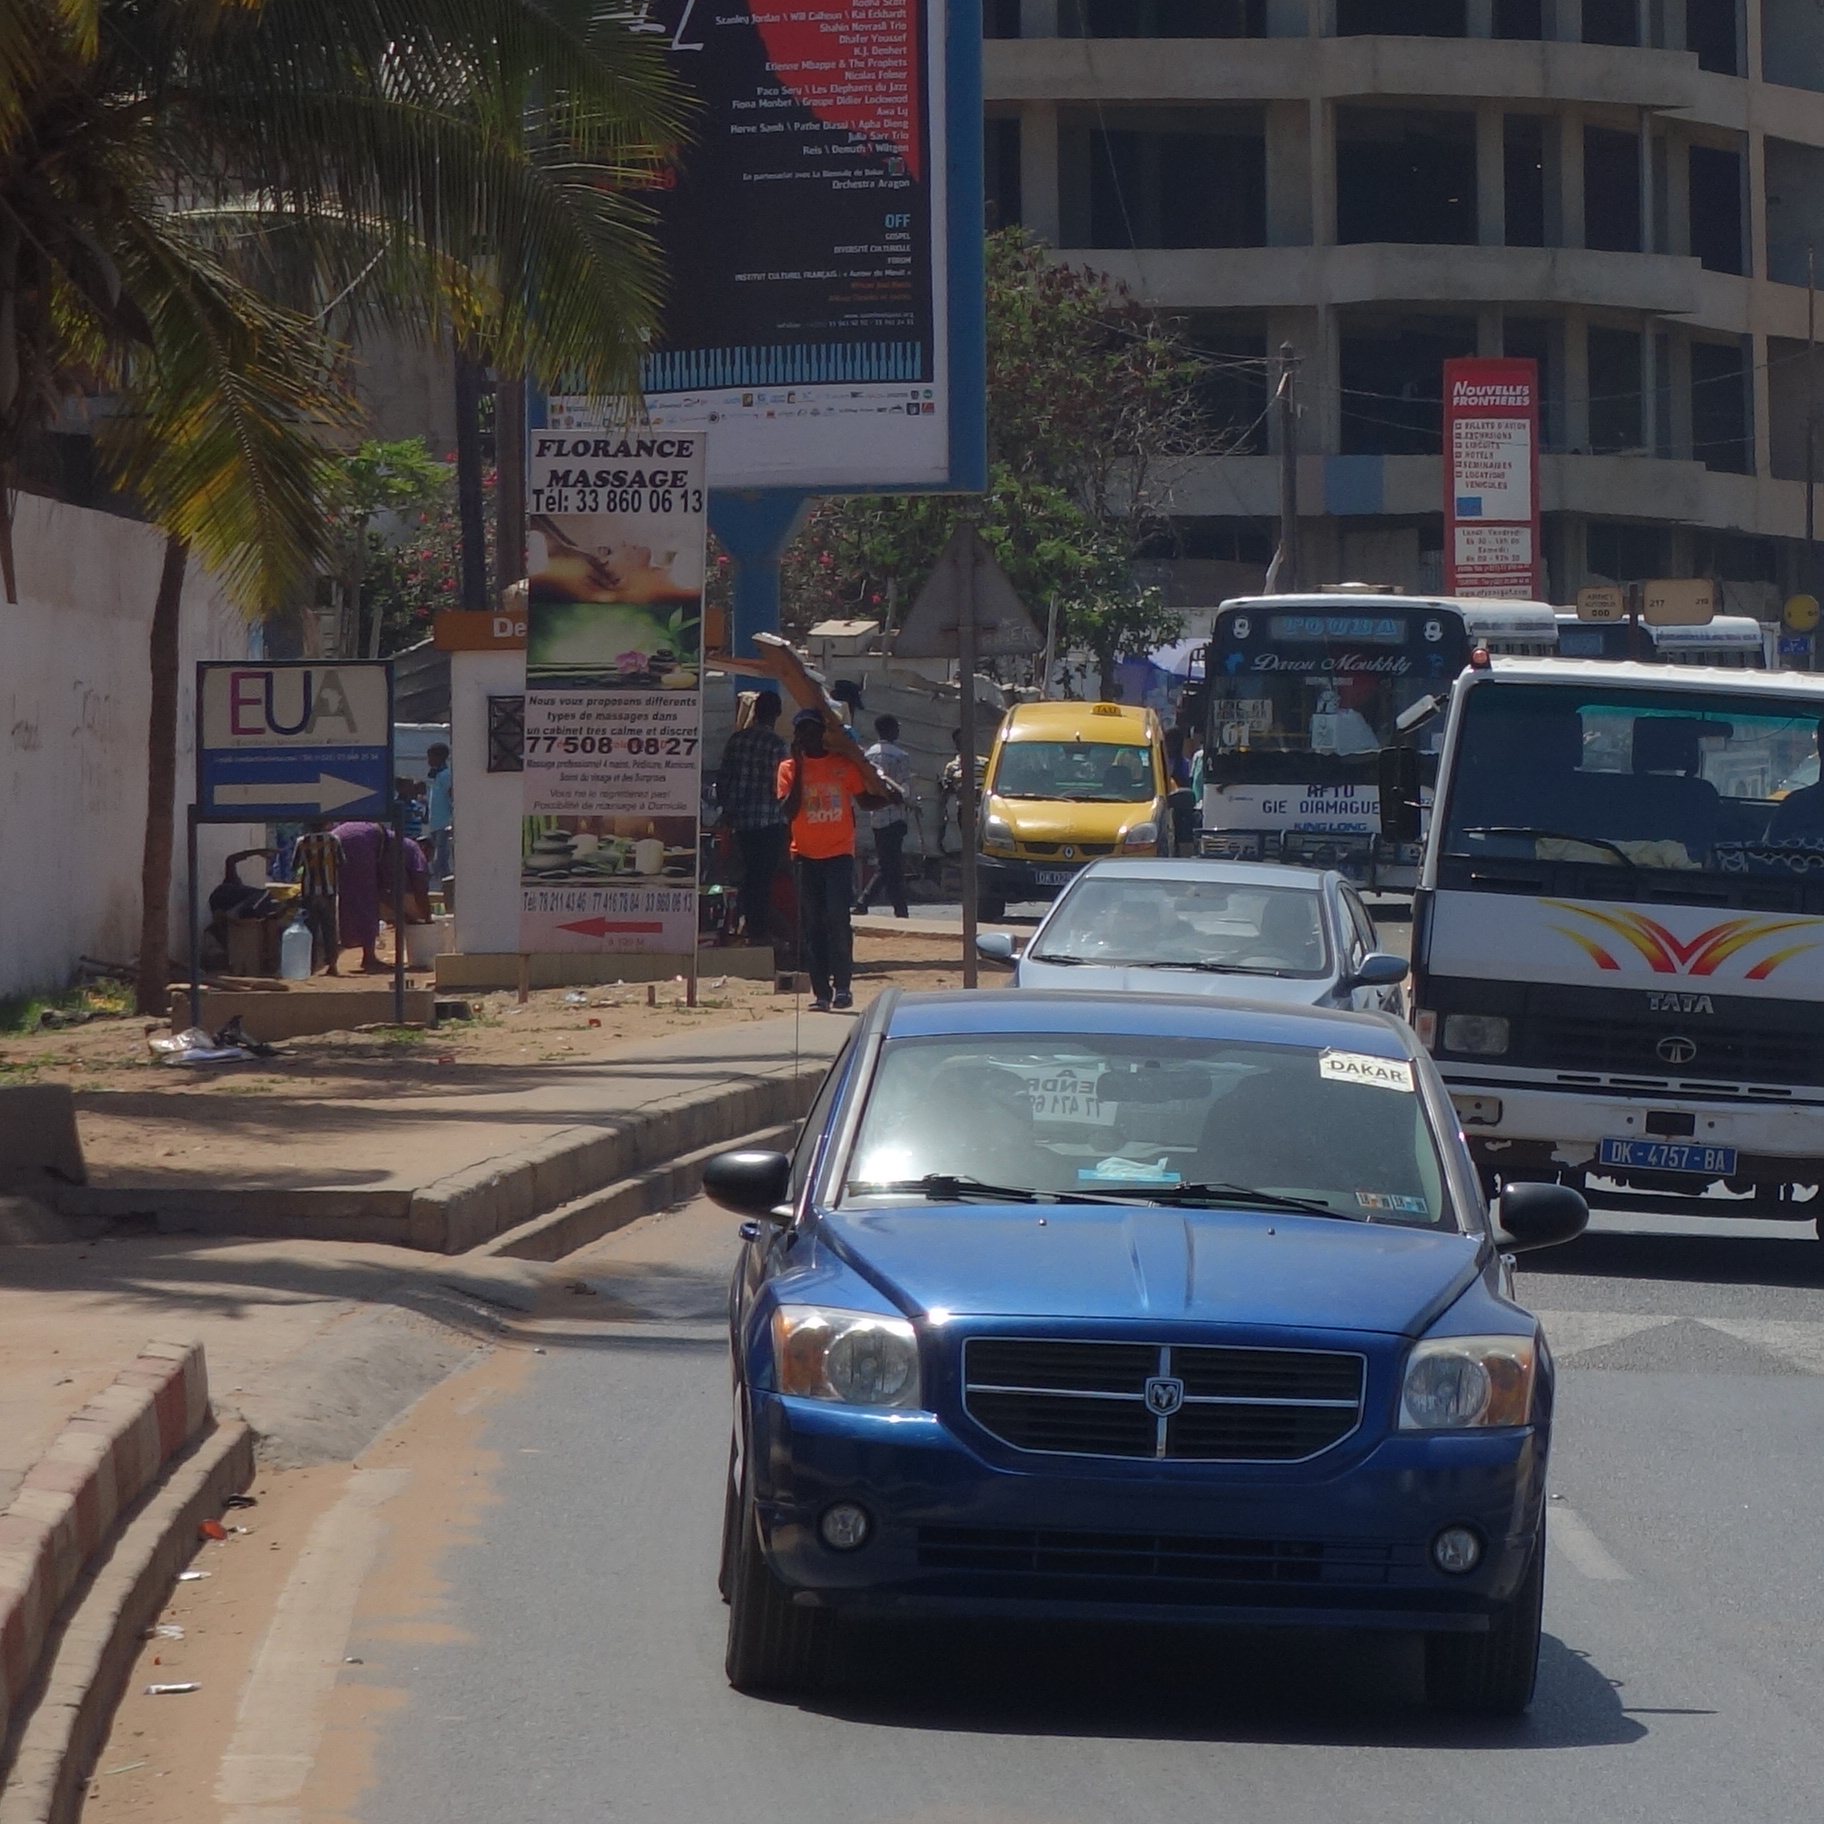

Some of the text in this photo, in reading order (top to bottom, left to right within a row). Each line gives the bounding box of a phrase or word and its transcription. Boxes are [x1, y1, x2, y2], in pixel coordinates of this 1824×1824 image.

[715, 14, 780, 26] Stanley Jordan
[890, 21, 907, 30] Trio
[849, 59, 865, 68] The
[868, 58, 908, 68] Prophets
[892, 129, 909, 139] Trio
[832, 178, 910, 190] Orchestra Aragon
[884, 213, 911, 228] OFF
[1453, 380, 1530, 396] NOUVELLES
[535, 439, 694, 457] FLORANCE
[546, 469, 689, 488] MASSAGE
[532, 488, 702, 513] Tél: 33 860 06 13
[1284, 617, 1397, 637] TOUBA
[1250, 653, 1315, 672] Darou
[230, 670, 358, 735] EUA
[529, 696, 641, 708] Nous vous proposons
[547, 711, 677, 723] types de massages dans
[1096, 706, 1118, 714] TAXI
[526, 726, 697, 736] un cabinet calme et discret
[1223, 722, 1250, 745] 61
[550, 789, 571, 798] Vous
[582, 801, 594, 809] de
[648, 801, 687, 810] Domicile
[1262, 800, 1288, 814] GIE
[807, 810, 842, 824] 2012
[1647, 991, 1715, 1015] TATA
[1331, 1059, 1403, 1082] DAKAR
